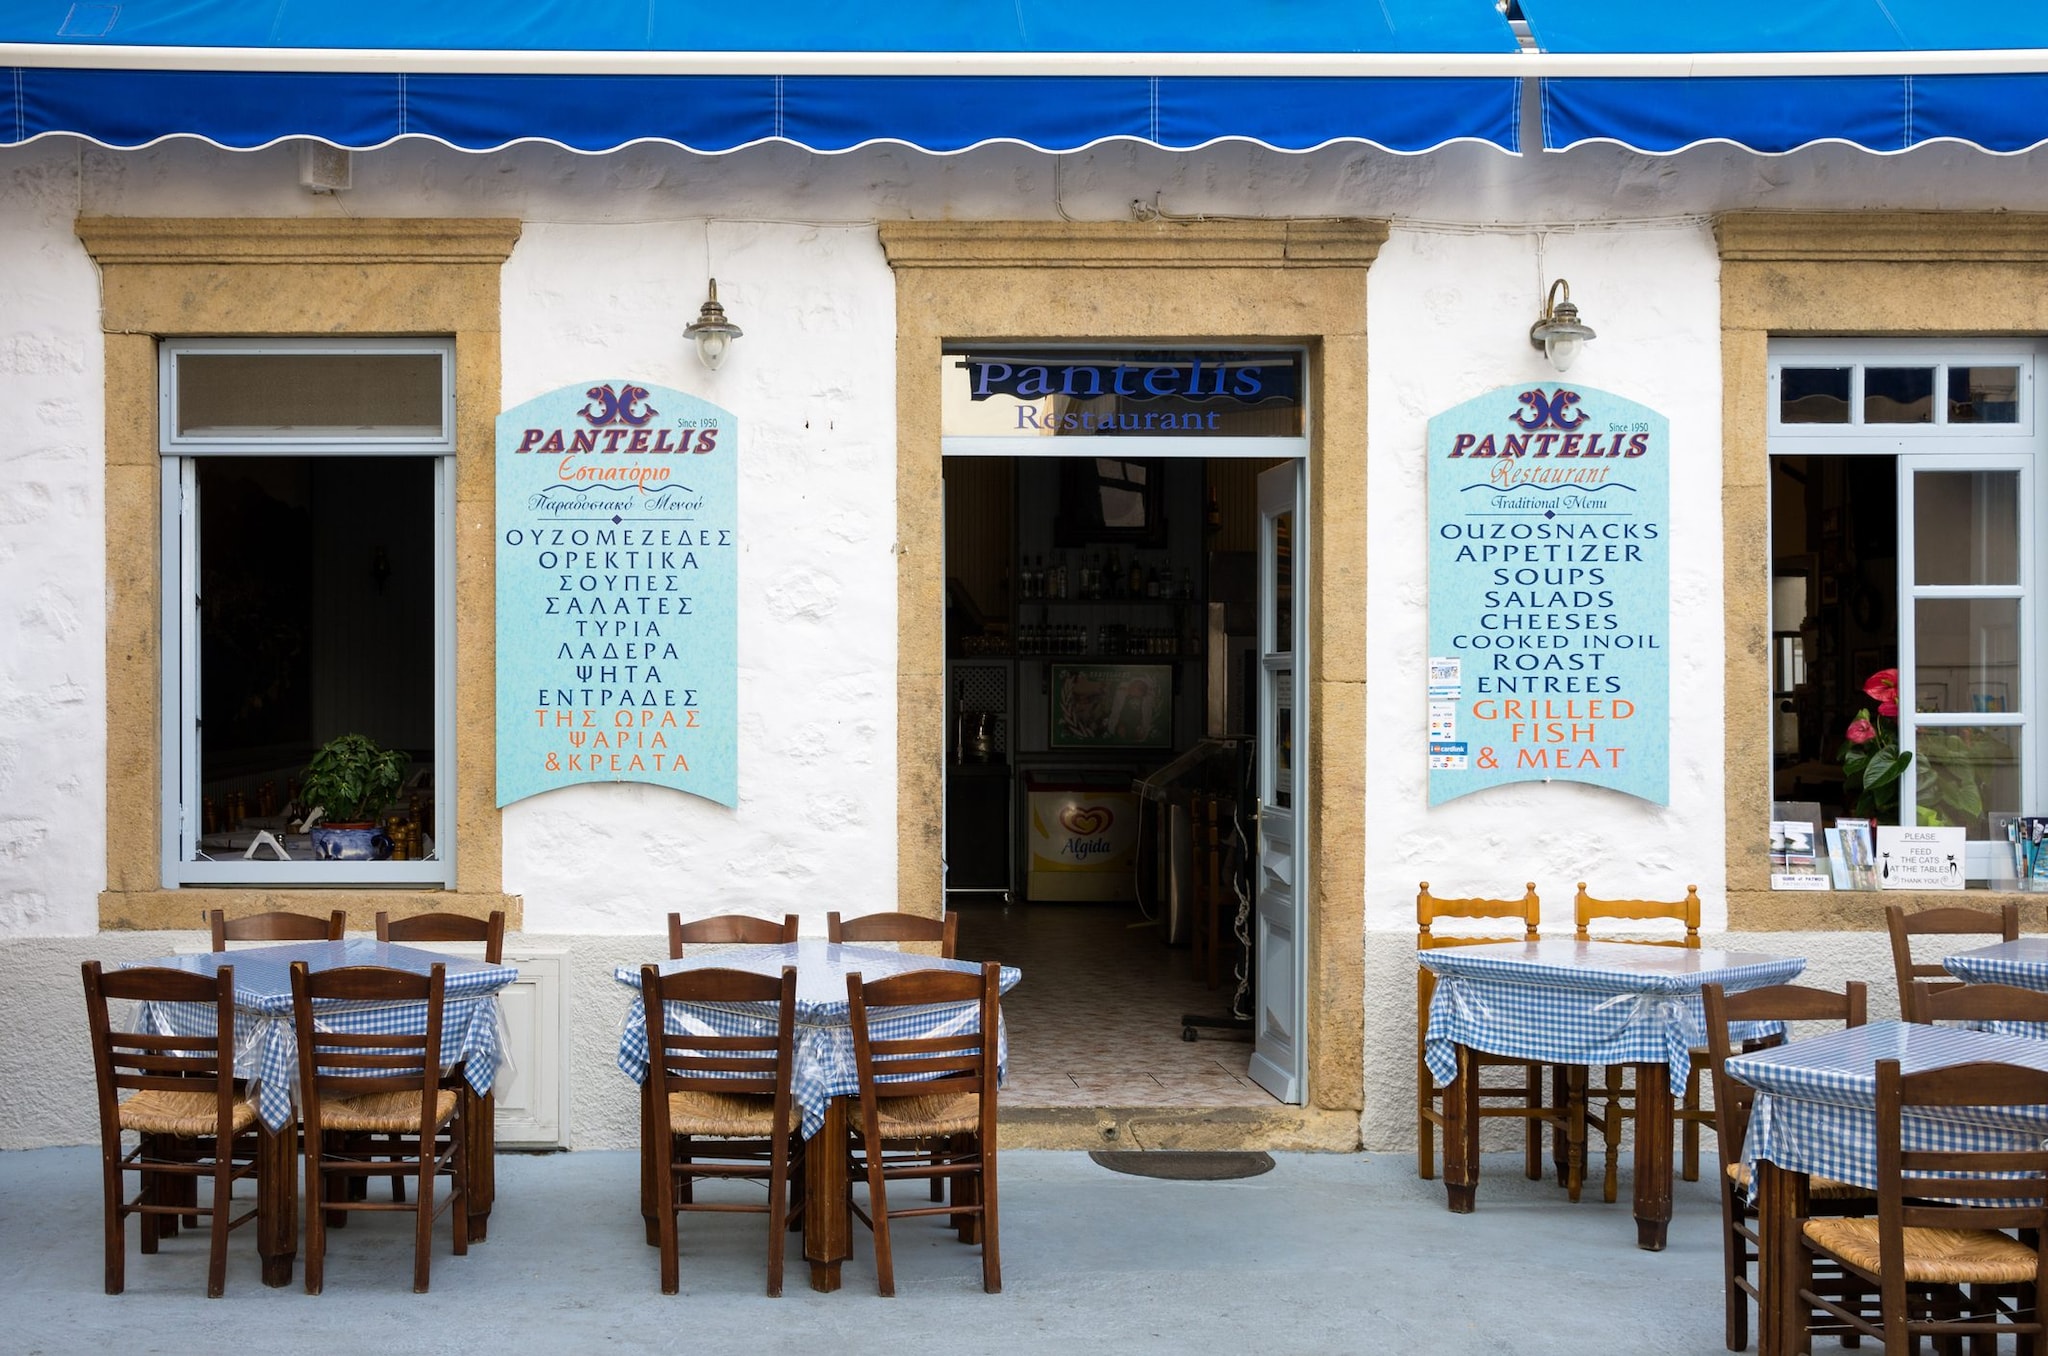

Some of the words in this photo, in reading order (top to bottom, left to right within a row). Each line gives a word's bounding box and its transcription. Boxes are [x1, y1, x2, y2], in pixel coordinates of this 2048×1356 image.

[972, 358, 1263, 396] Pantelis
[678, 418, 697, 428] Since
[700, 418, 718, 428] 1950
[1014, 404, 1220, 430] Restaurant
[1609, 422, 1628, 432] Since
[1631, 422, 1648, 432] 1950
[515, 429, 718, 454] PANTELIS
[1448, 434, 1650, 458] PANTELIS
[558, 455, 671, 496] Εστιατόριο
[1490, 458, 1610, 487] Restaurant
[528, 494, 633, 516] Παραδοσιακό
[644, 494, 704, 512] Μενού
[1491, 495, 1560, 509] Traditional
[1563, 495, 1608, 509] Menu
[506, 529, 732, 546] ΟΥΖΟΜΕΖΕΔΕΣ
[1440, 524, 1659, 540] OUZOSNACKS
[539, 551, 699, 570] ΟΡΕΚΤΙΚΑ
[1455, 544, 1643, 562] APPETIZER
[559, 574, 678, 592] ΣΟΥΠΕΣ
[1494, 568, 1605, 586] SOUPS
[545, 597, 692, 614] ΣΑΛΑΤΕΣ
[1484, 591, 1614, 608] SALADS
[576, 620, 661, 636] ΤΥΡΙΑ
[1480, 614, 1618, 630] CHEESES
[1452, 634, 1569, 649] COOKED
[557, 642, 679, 660] ΛΑΔΕΡΑ
[1494, 654, 1605, 670] ROAST
[576, 666, 662, 683] ΨΗΤΑ
[1478, 676, 1622, 694] ENTREES
[539, 690, 698, 706] ΕΝΤΡΑΔΕΣ
[535, 710, 597, 728] ΤΗΣ
[614, 710, 700, 728] ΩΡΑΣ
[1472, 700, 1635, 720] GRILLED
[569, 731, 668, 748] ΨΑΡΙΑ
[1511, 722, 1595, 742] FISH
[1476, 746, 1500, 768] &
[1517, 748, 1625, 768] MEAT
[1061, 837, 1111, 860] Algida
